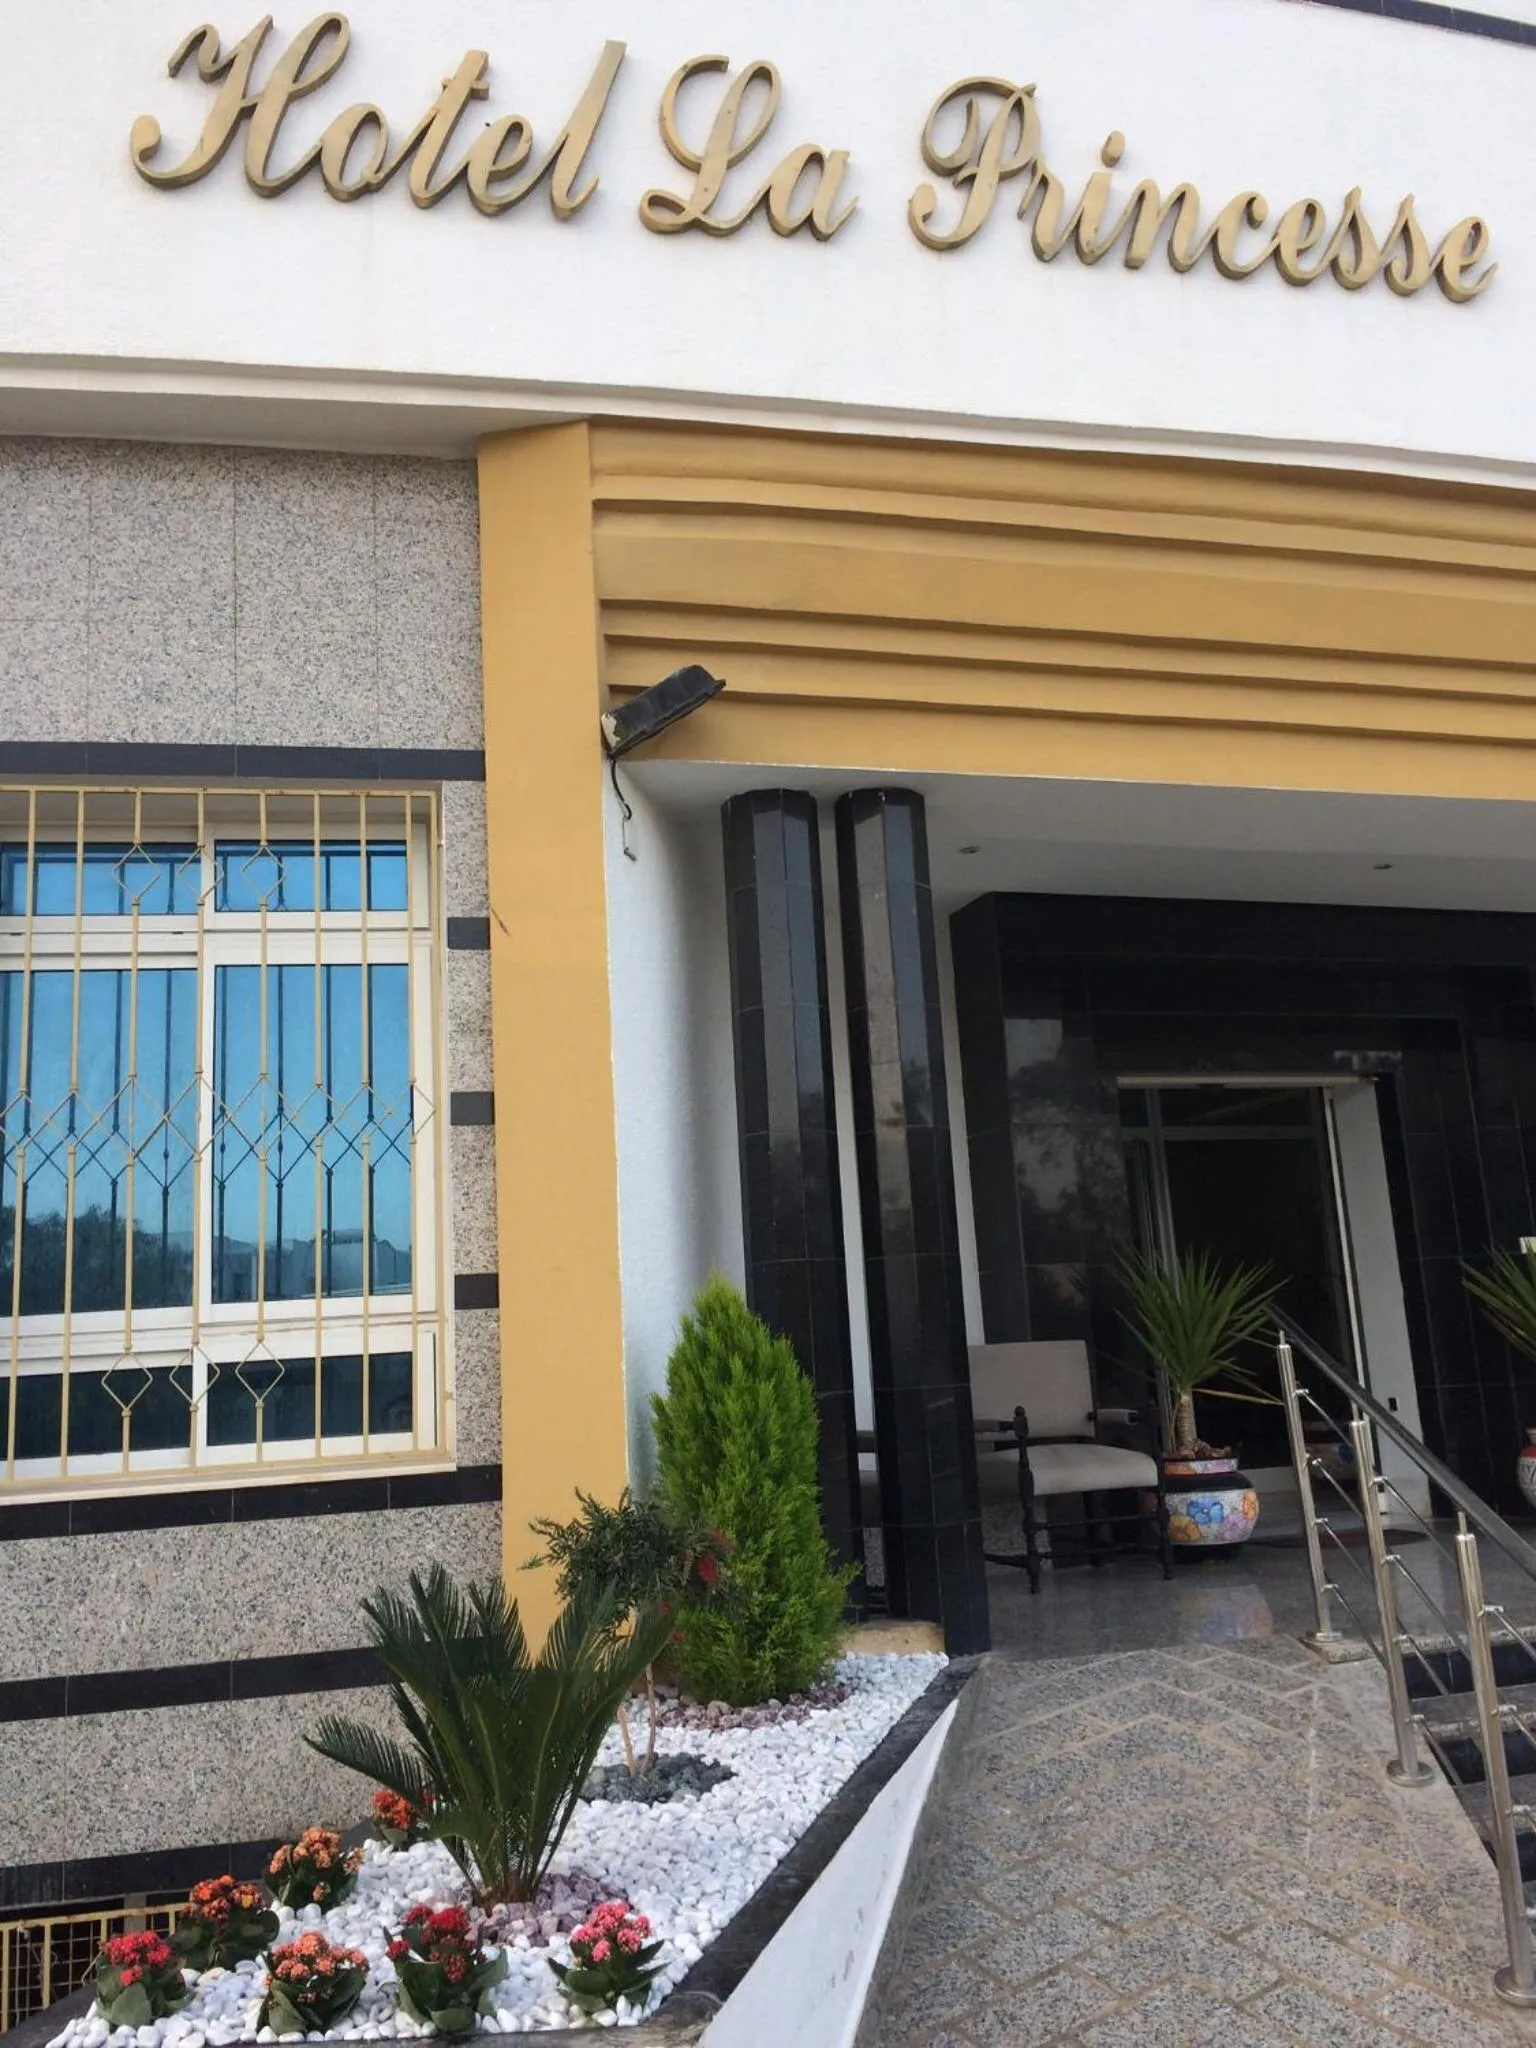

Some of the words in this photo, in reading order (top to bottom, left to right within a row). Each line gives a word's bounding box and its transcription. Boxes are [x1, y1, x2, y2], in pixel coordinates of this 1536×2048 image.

[131, 11, 627, 221] Hotel
[639, 54, 861, 242] La
[908, 76, 1498, 303] Princesse
